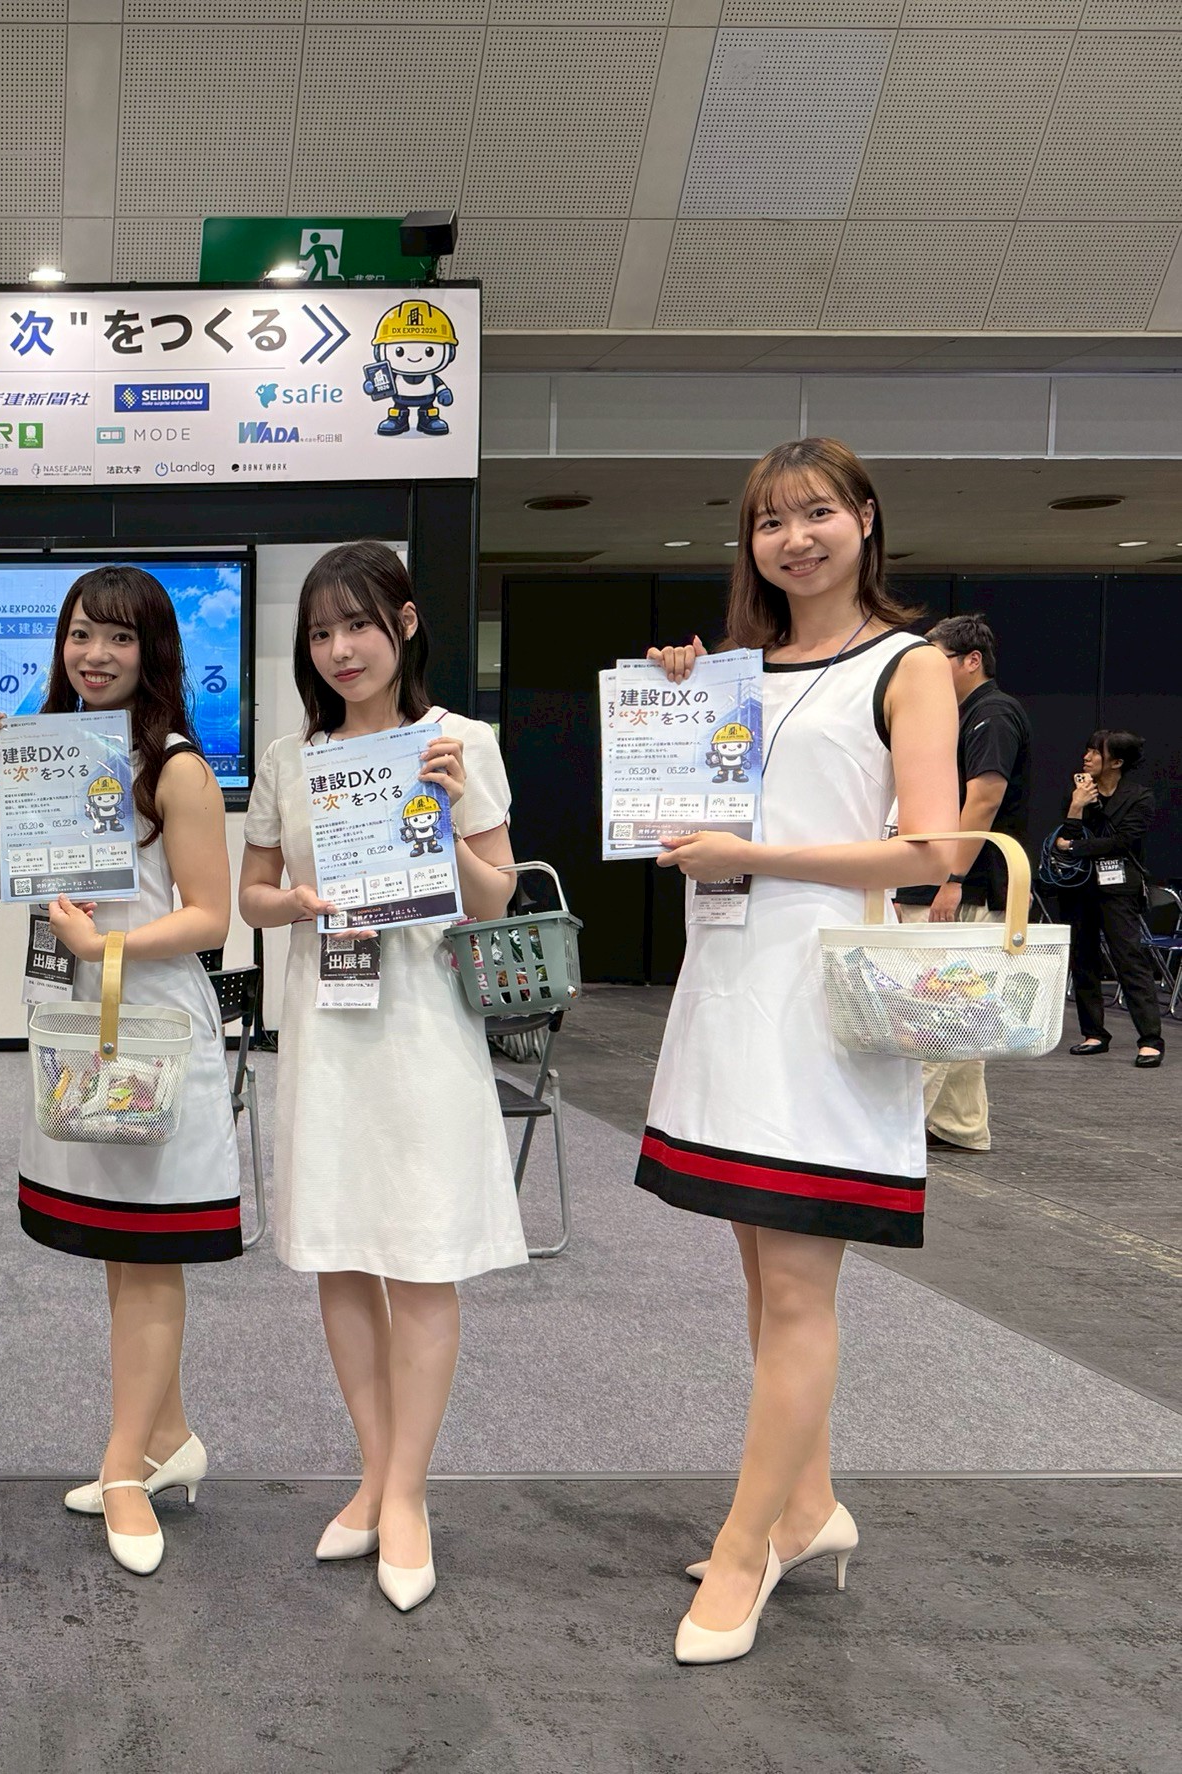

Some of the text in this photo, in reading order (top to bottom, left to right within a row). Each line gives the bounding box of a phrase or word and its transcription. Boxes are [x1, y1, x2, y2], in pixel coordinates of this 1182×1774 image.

[104, 307, 286, 354] をつくる
[141, 389, 203, 401] SEIBIDOU
[282, 384, 343, 404] safie
[134, 428, 190, 441] MODE
[239, 422, 300, 443] WADA
[107, 466, 141, 474] 法政大学
[171, 461, 215, 475] Landlog
[201, 664, 228, 694] る
[620, 689, 708, 707] 建設DXの
[2, 745, 80, 765] 建設DXの
[310, 767, 392, 795] 建設DXの
[33, 953, 69, 973] 出展者
[328, 952, 372, 970] 出展者
